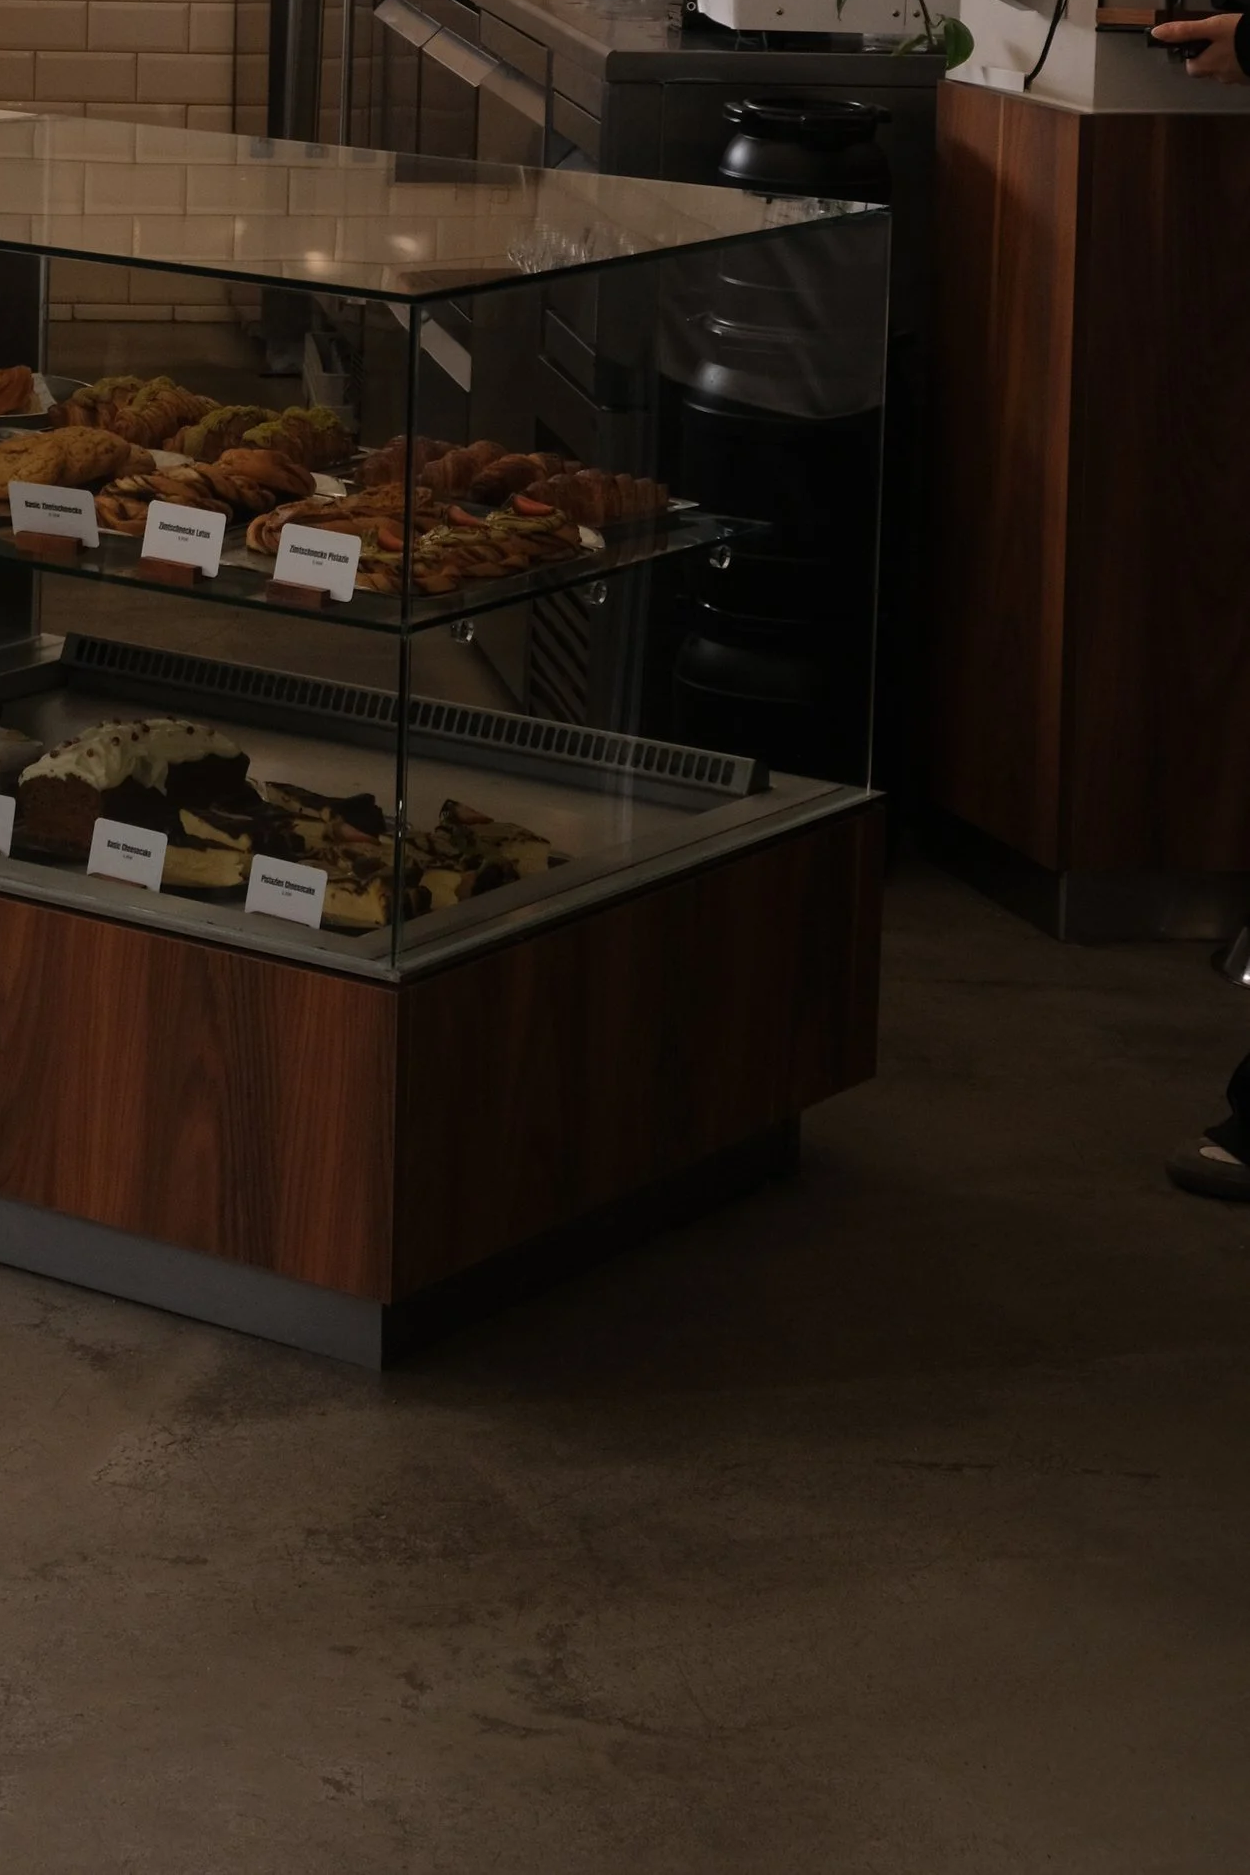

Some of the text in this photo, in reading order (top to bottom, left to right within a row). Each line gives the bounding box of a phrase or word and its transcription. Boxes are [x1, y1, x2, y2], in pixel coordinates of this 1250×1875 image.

[158, 521, 196, 536] Zimtschnecke
[289, 544, 328, 560] Zimtschnecke
[121, 843, 152, 858] Cheesecake
[285, 880, 316, 896] Cheesecake
